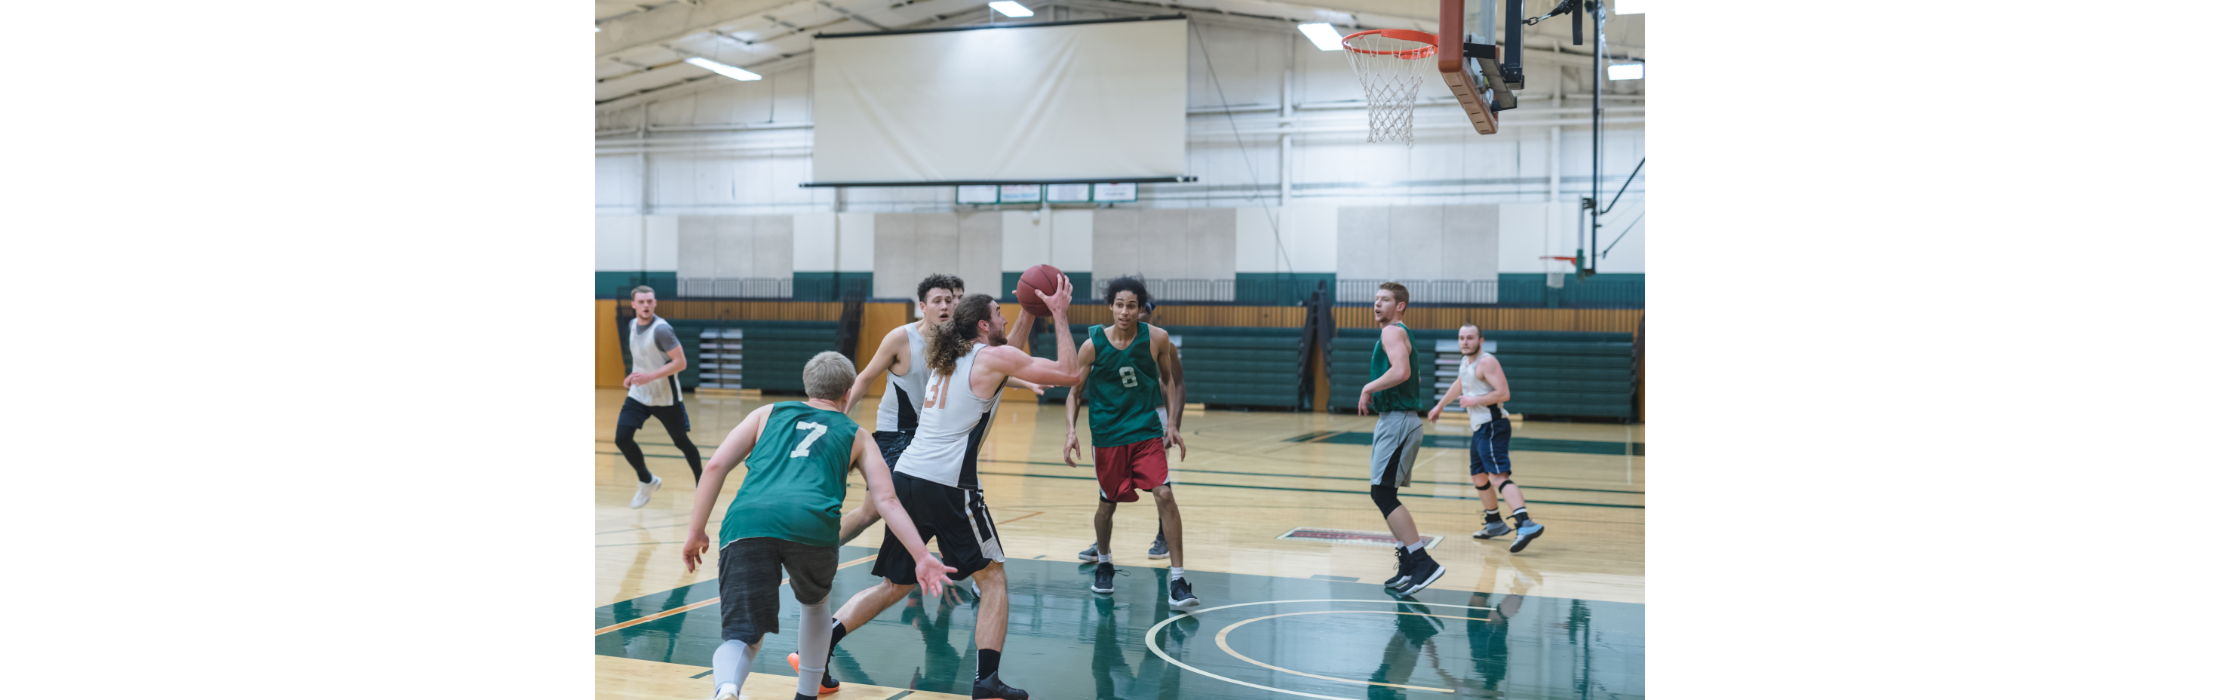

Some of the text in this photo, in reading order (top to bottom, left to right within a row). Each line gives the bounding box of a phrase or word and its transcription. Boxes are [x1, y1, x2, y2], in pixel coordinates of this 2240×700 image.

[924, 371, 951, 409] 31
[1119, 366, 1138, 388] 8
[790, 420, 828, 458] 7
